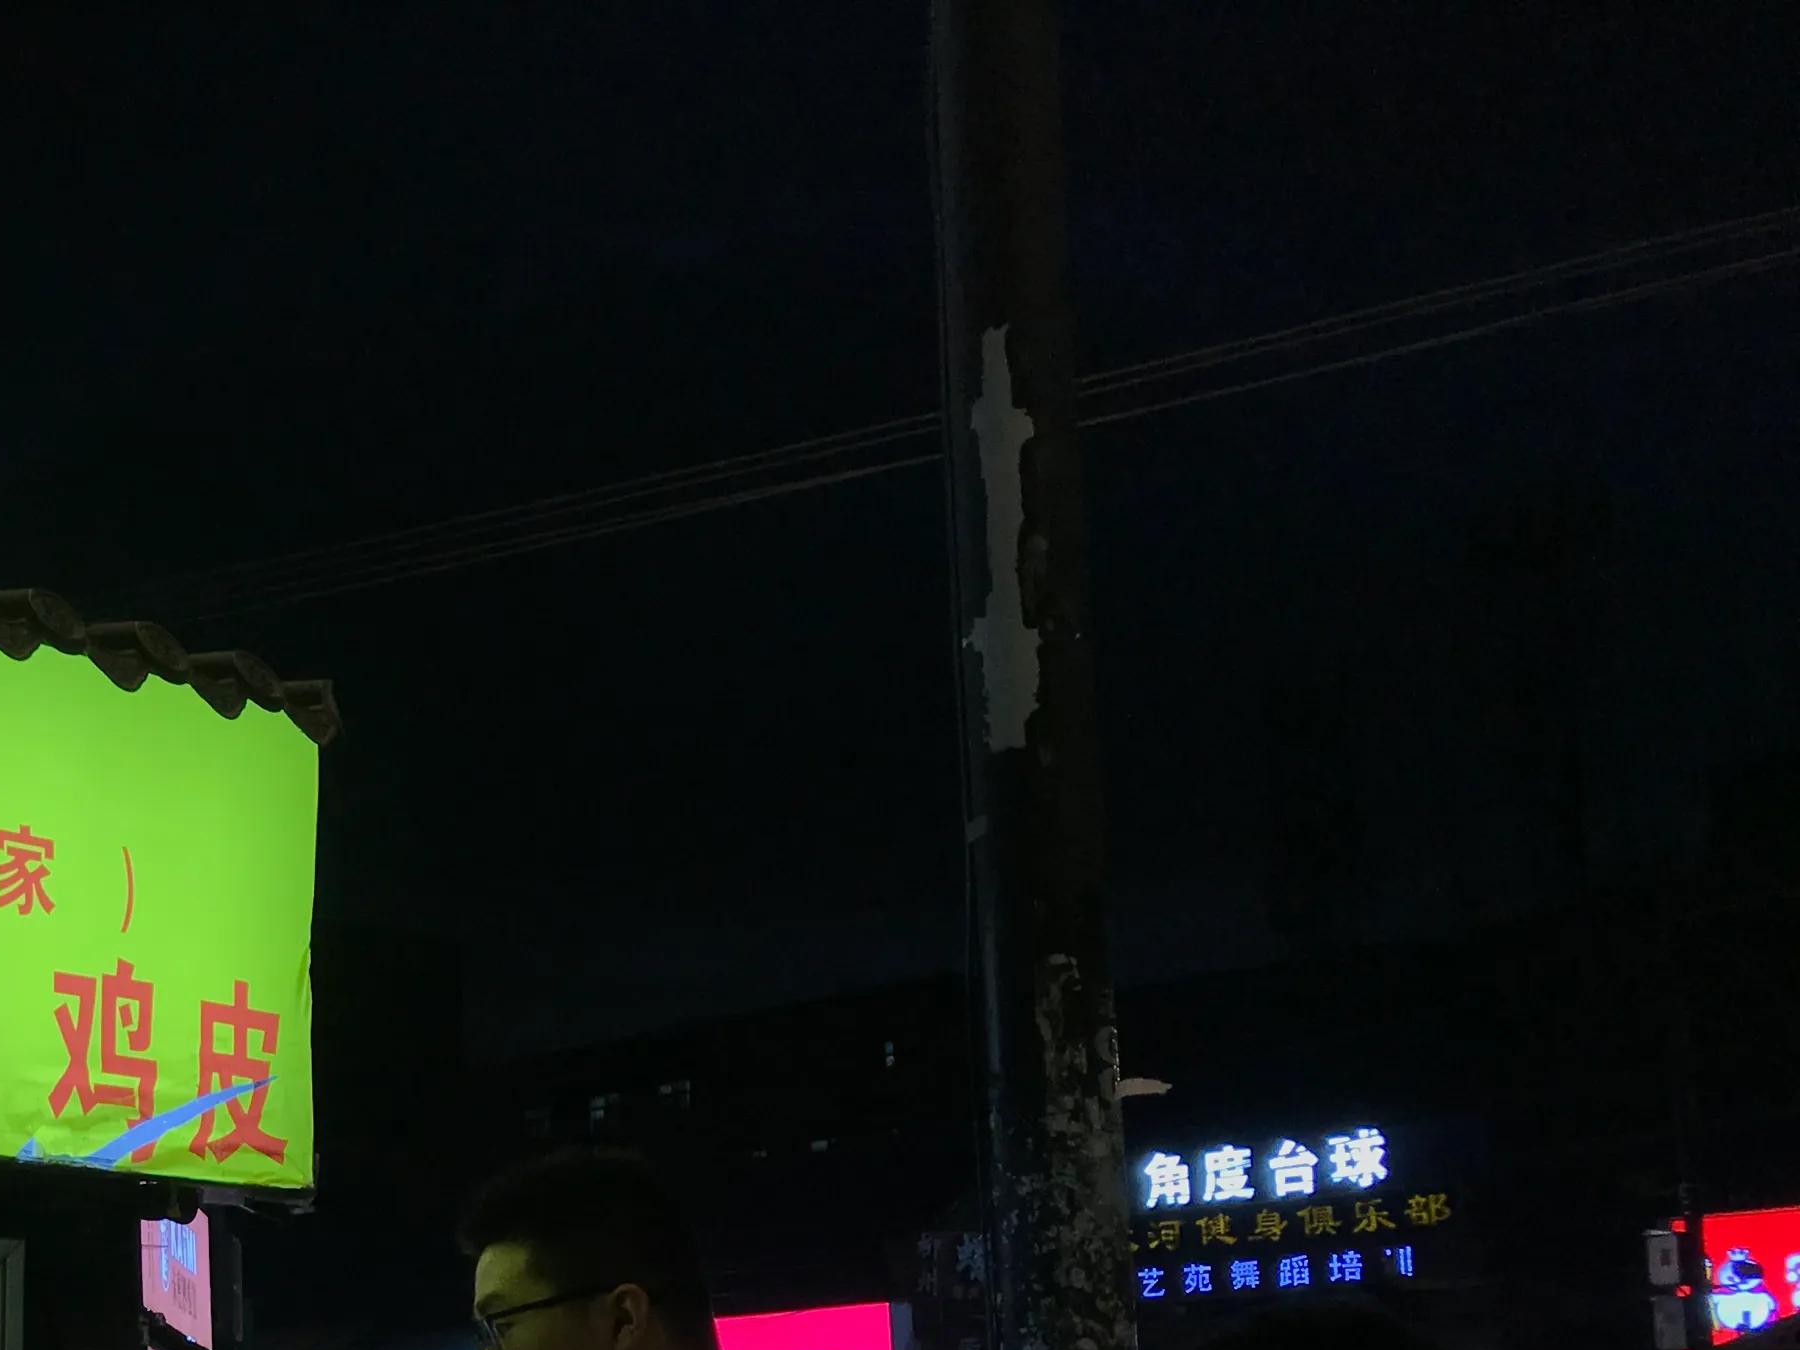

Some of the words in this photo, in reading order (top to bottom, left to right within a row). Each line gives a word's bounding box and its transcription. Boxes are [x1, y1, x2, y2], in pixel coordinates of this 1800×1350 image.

[48, 958, 288, 1165] 鸡皮
[1144, 1126, 1389, 1208] 角度台球
[1127, 1192, 1453, 1252] 河健身俱乐部
[1137, 1245, 1415, 1299] 艺苑舞蹈培训
